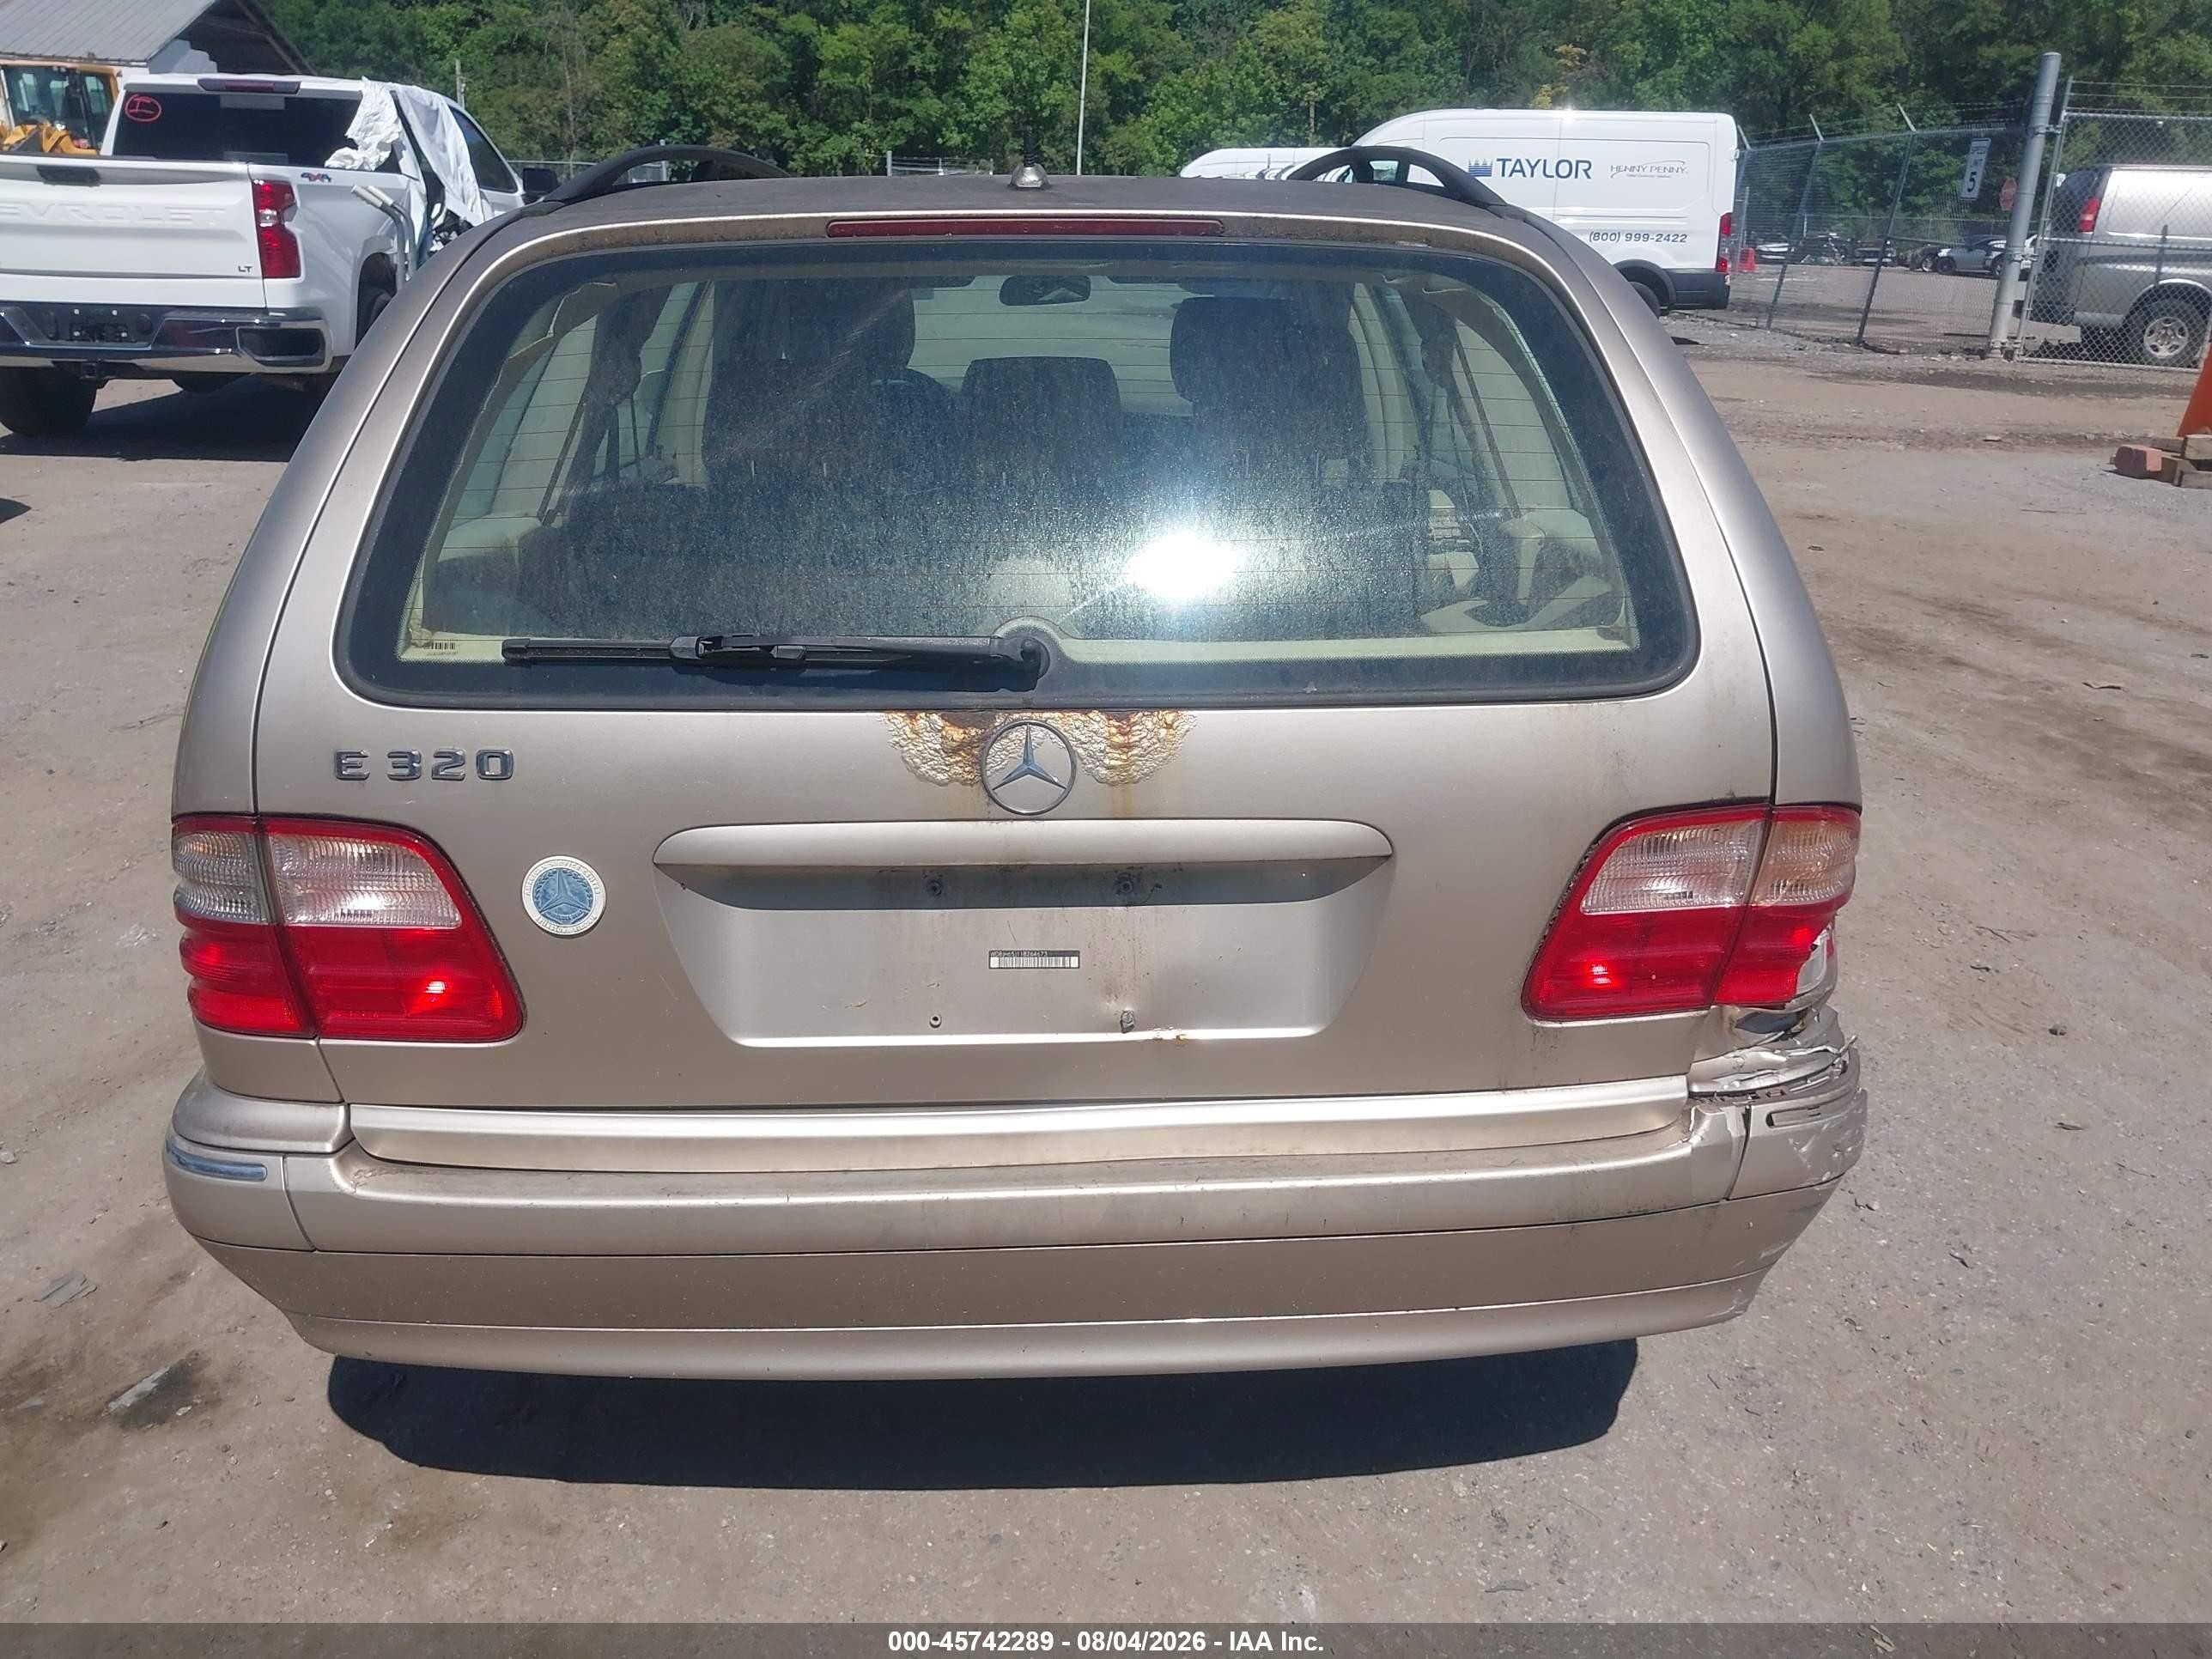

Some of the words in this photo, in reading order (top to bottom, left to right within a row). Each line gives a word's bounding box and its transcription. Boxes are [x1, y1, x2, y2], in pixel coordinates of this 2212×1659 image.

[1497, 158, 1592, 179] TAYLOR
[1967, 172, 1977, 192] 5
[1589, 231, 1620, 242] (800)
[1625, 233, 1687, 243] 999-2422
[334, 750, 370, 781] E
[386, 749, 514, 781] 320
